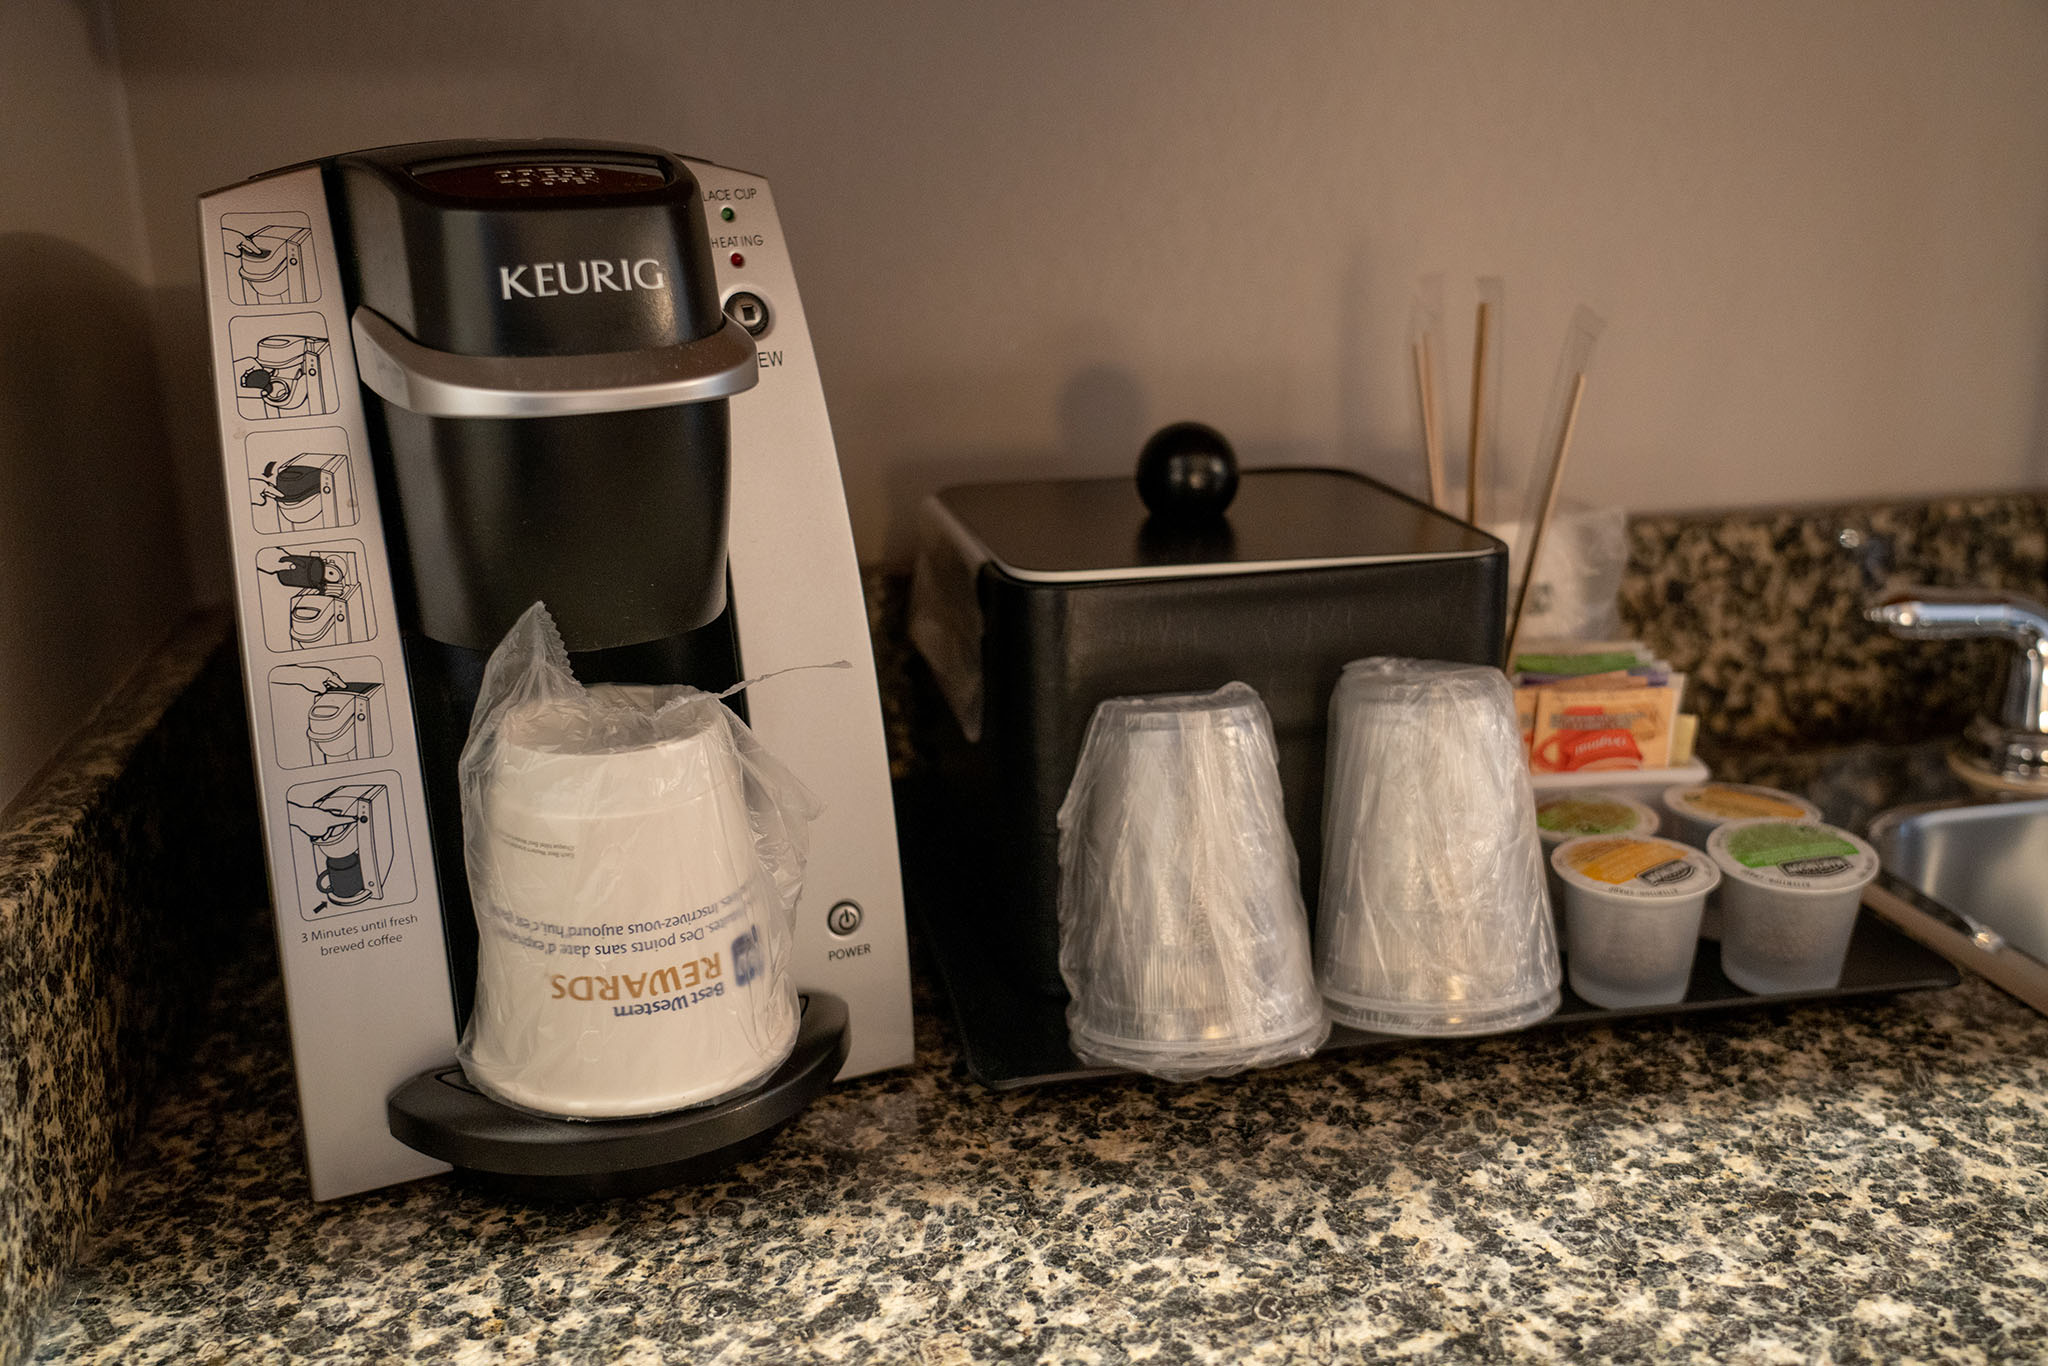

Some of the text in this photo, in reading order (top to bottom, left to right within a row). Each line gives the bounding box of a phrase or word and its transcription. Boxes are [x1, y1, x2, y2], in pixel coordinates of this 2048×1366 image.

[702, 188, 758, 202] LACE CUP
[711, 234, 764, 248] HEATING
[500, 258, 665, 300] KEURIG
[758, 351, 783, 368] EW
[301, 914, 418, 943] 3 Minutes until fresh
[628, 904, 719, 936] Inscrivez-vous
[631, 932, 677, 954] points
[687, 926, 705, 943] Des
[320, 934, 403, 956] brewed coffee
[559, 943, 591, 958] date
[595, 943, 627, 956] sans
[828, 943, 872, 961] POWER
[551, 952, 723, 1002] REWARDS
[613, 981, 725, 1017] Best Western
